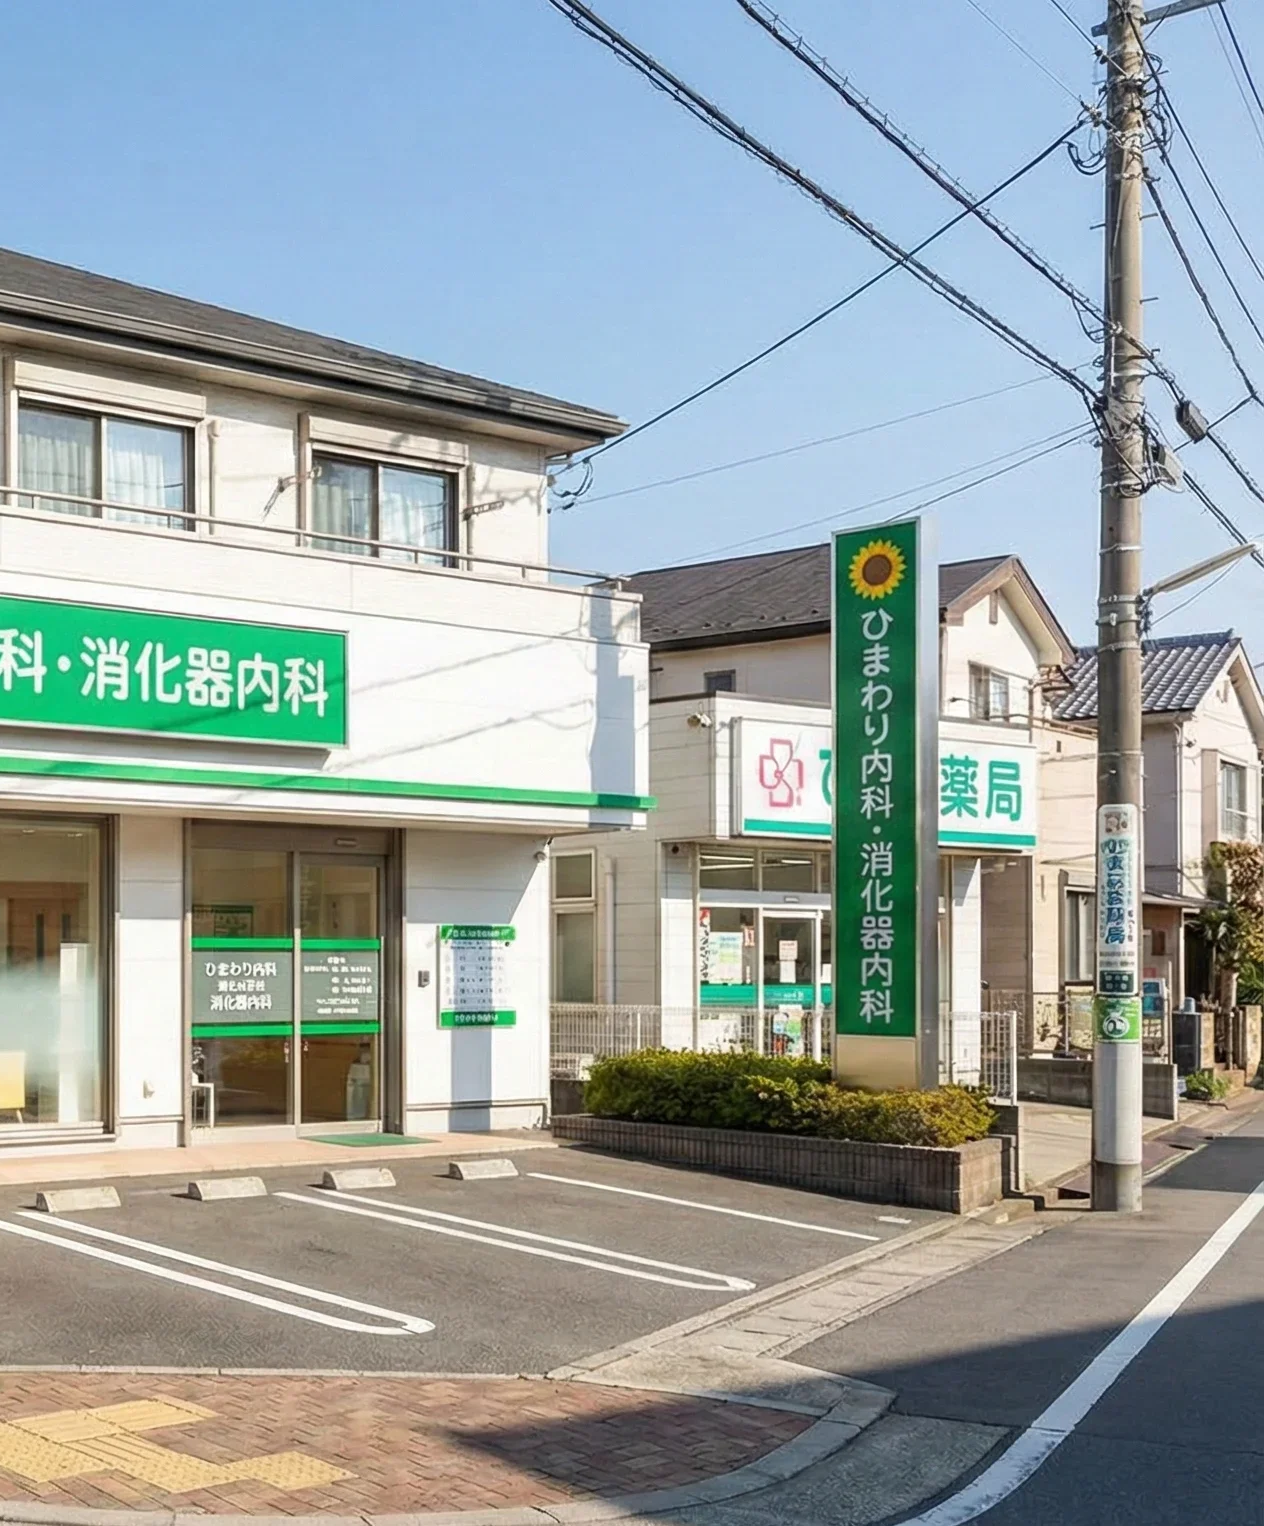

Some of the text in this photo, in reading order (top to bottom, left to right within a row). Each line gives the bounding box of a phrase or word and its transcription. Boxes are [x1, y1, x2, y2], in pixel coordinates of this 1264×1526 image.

[859, 607, 894, 1024] ひまわり内科・消化器内科
